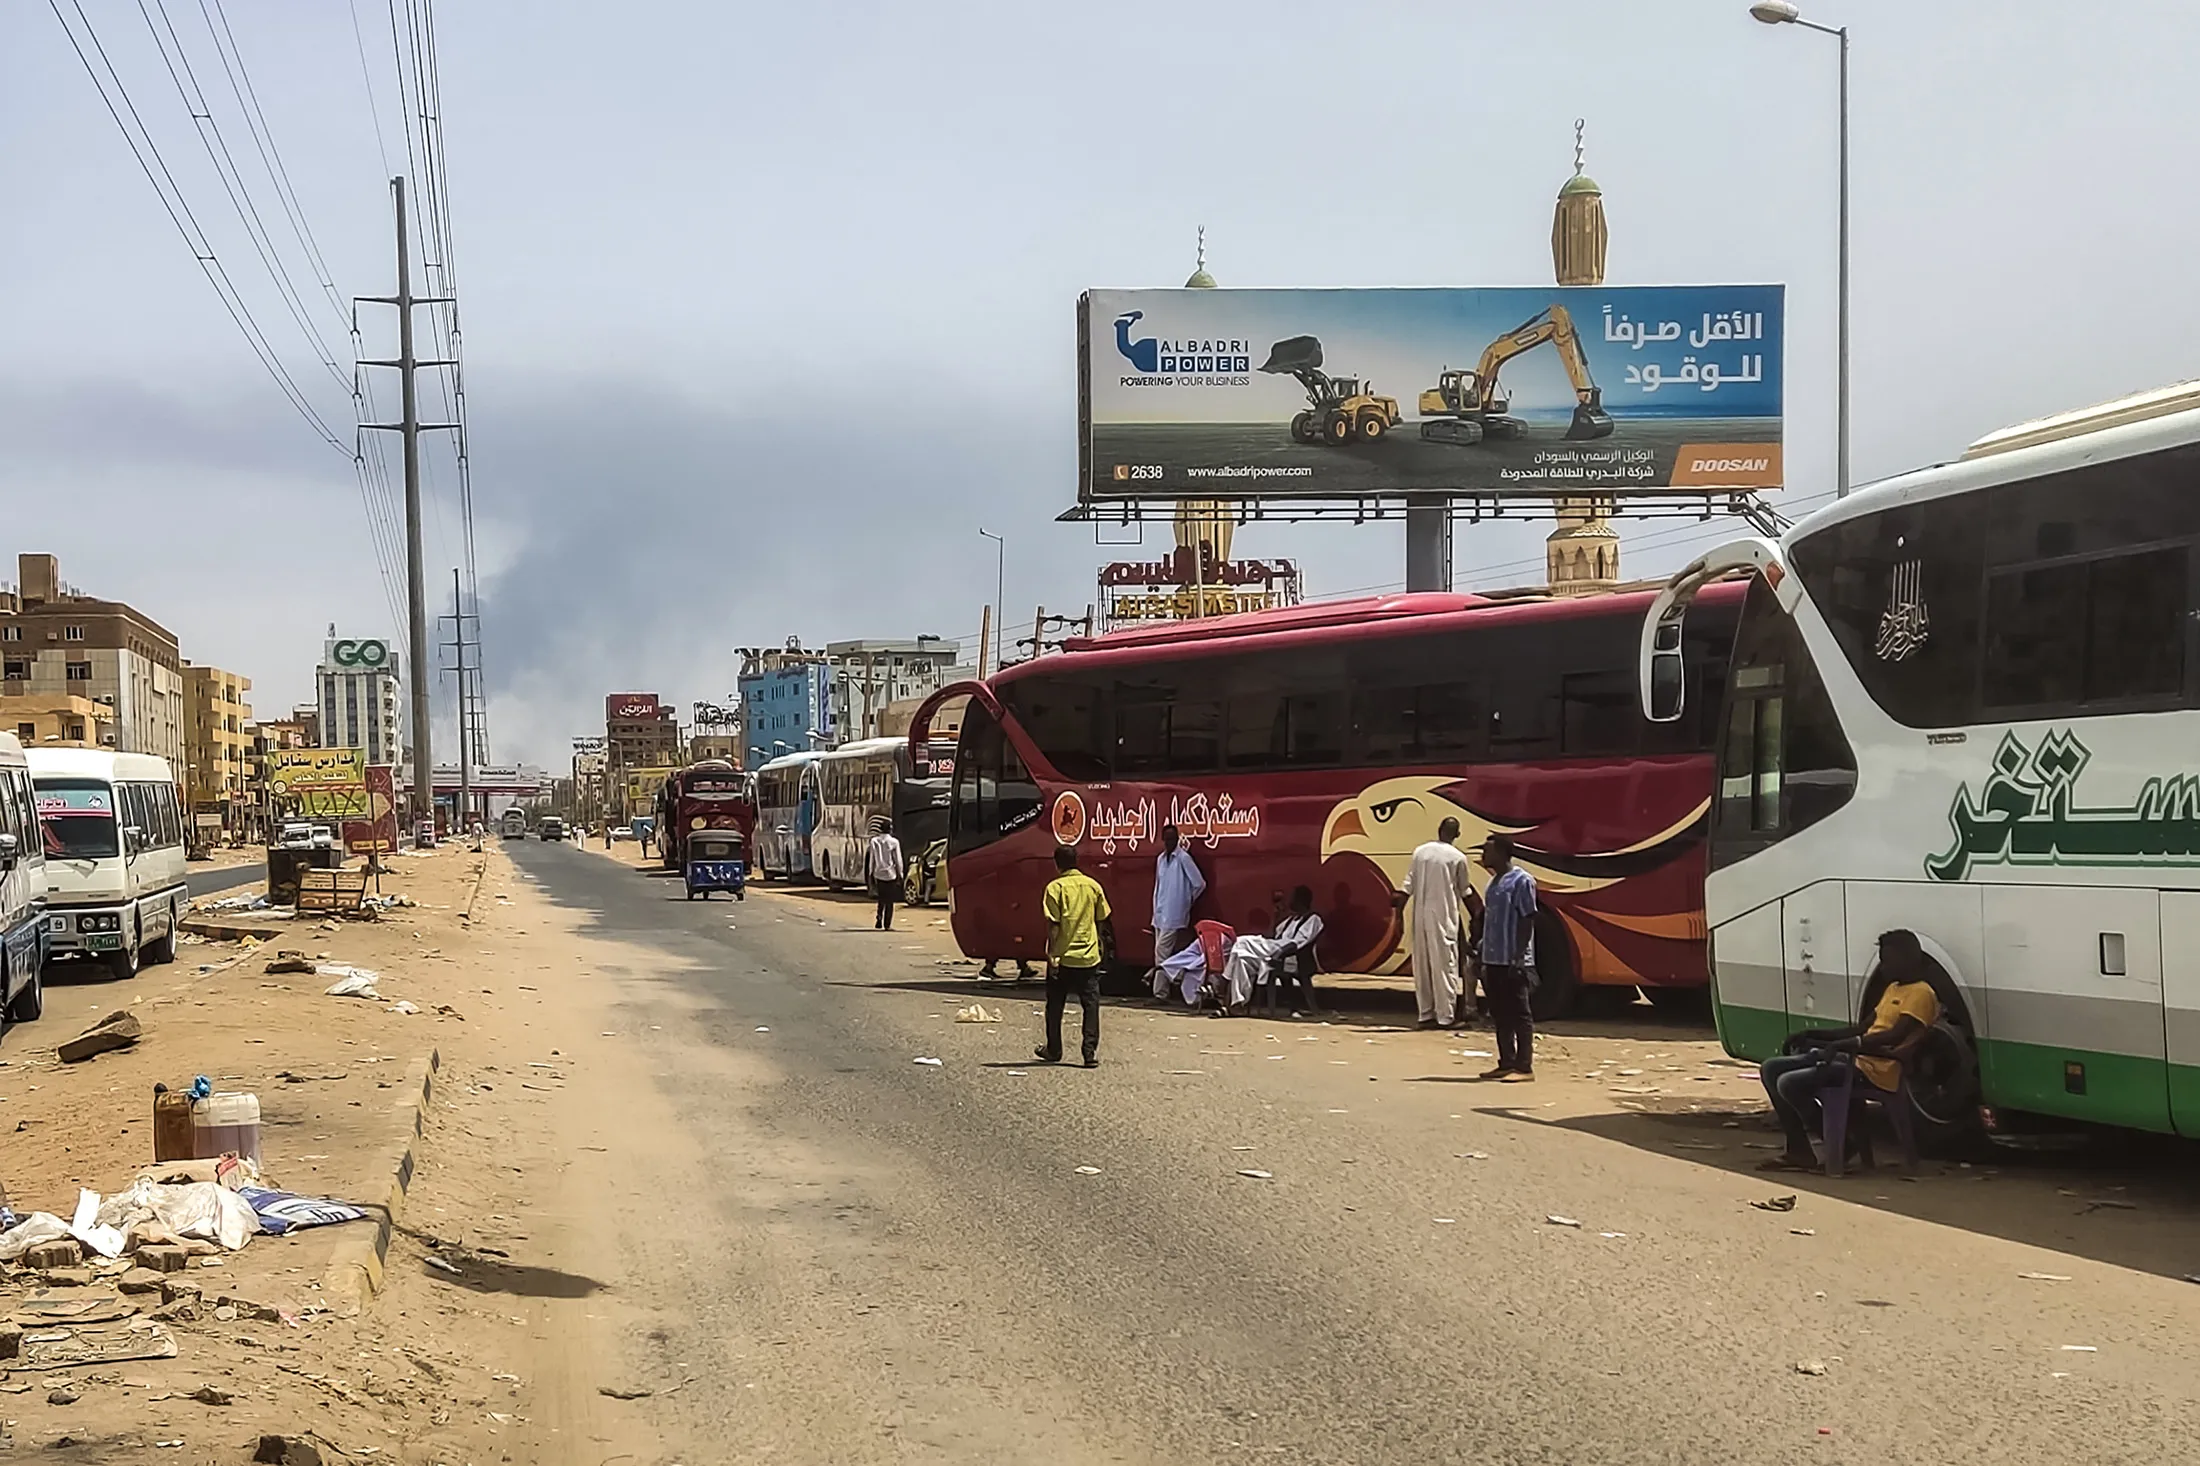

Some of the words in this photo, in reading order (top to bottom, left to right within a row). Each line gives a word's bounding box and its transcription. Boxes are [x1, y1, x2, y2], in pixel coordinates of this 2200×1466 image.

[1602, 304, 1682, 350] صرفاً
[1689, 310, 1763, 348] الأقل
[1160, 340, 1249, 353] ALBADRI
[1163, 358, 1248, 371] POWER
[1624, 354, 1762, 392] للوقود
[1120, 376, 1173, 386] POWERING
[1175, 376, 1204, 386] YOUR
[1206, 376, 1250, 386] BUSINESS
[1534, 450, 1579, 464] بالسودان
[1580, 449, 1621, 464] الرسمي
[1622, 449, 1654, 463] الوكيل
[1131, 465, 1163, 479] 2638
[1187, 465, 1312, 480] www.albadripower.com
[1549, 467, 1584, 478] للطاقة
[1626, 465, 1654, 480] شركة
[1690, 458, 1769, 473] DOOSAN
[1500, 467, 1548, 481] المحدودة
[333, 640, 387, 666] GO
[1090, 796, 1157, 856] الجديد
